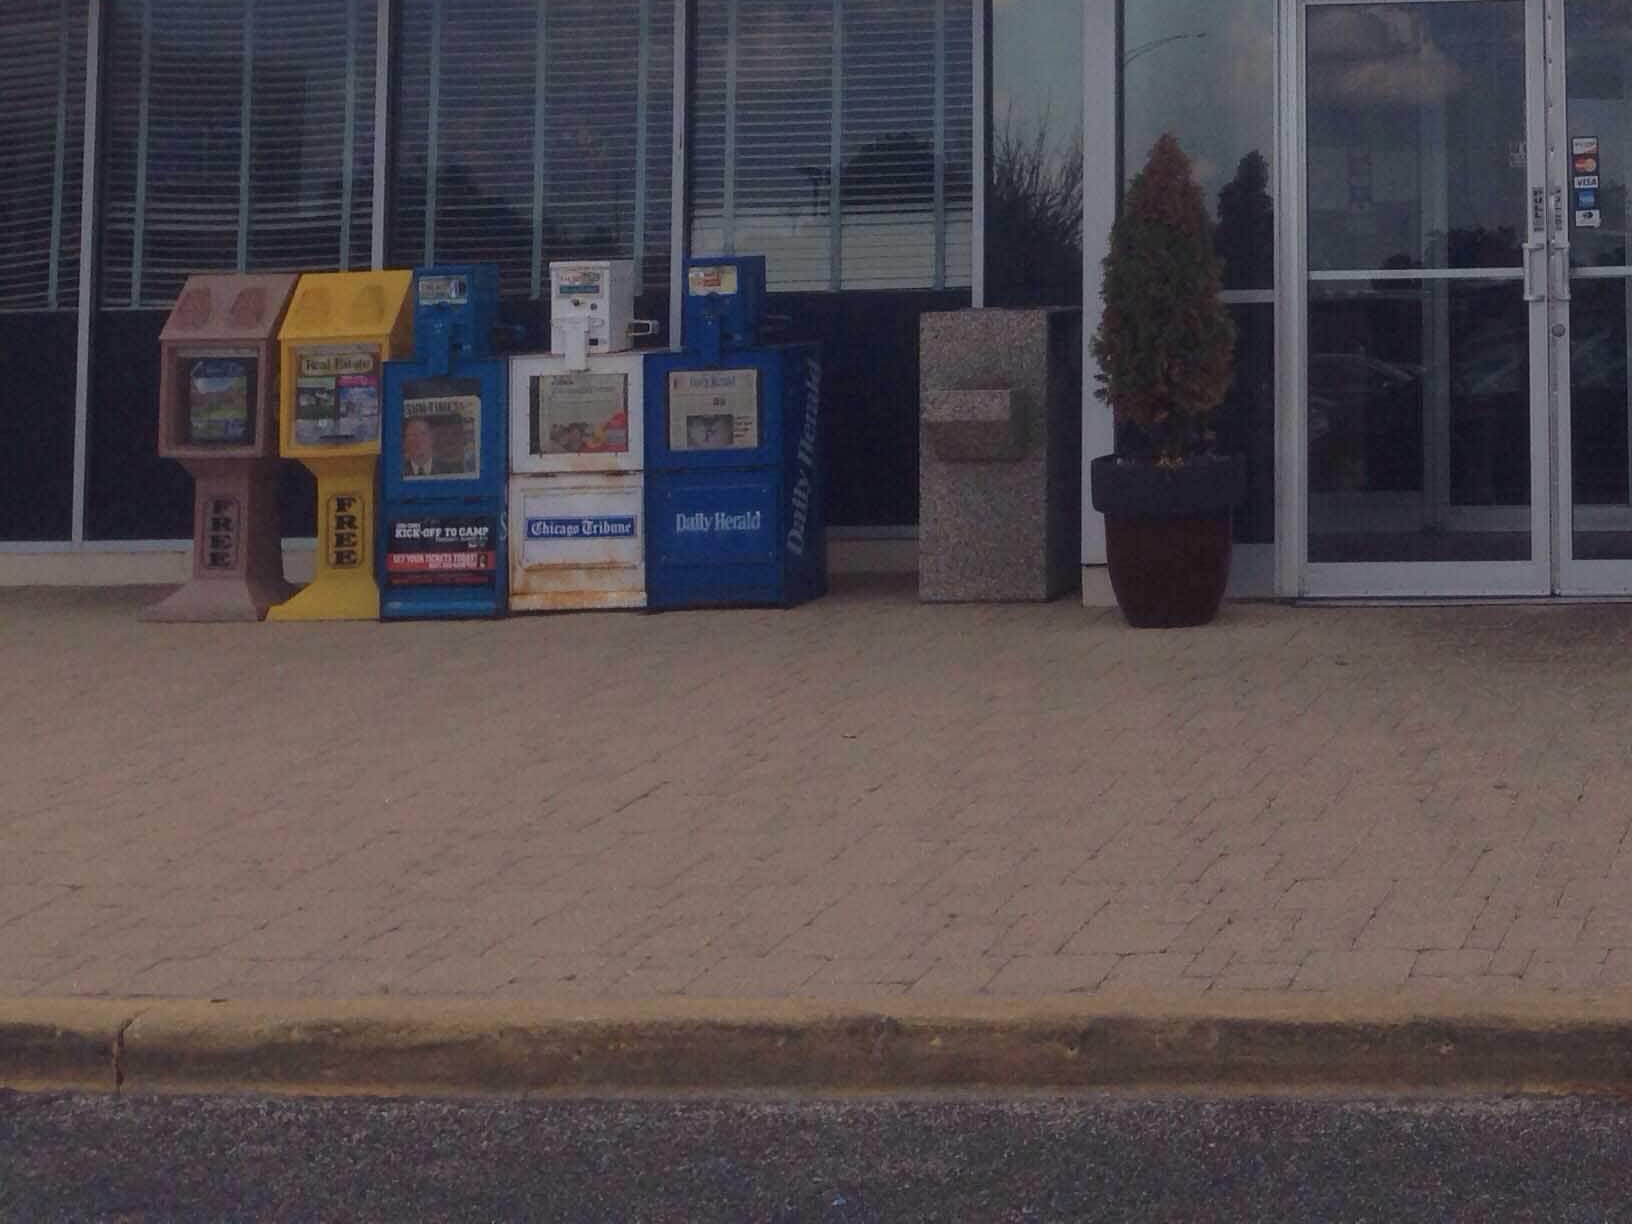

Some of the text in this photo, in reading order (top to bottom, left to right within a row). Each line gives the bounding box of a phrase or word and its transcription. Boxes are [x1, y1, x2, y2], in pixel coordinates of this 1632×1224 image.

[334, 495, 358, 566] FREE
[445, 526, 457, 537] TO
[459, 526, 489, 537] CAMP
[531, 518, 632, 537] Chicago Tribune
[675, 510, 761, 533] Daily Herald
[208, 500, 233, 568] FREE
